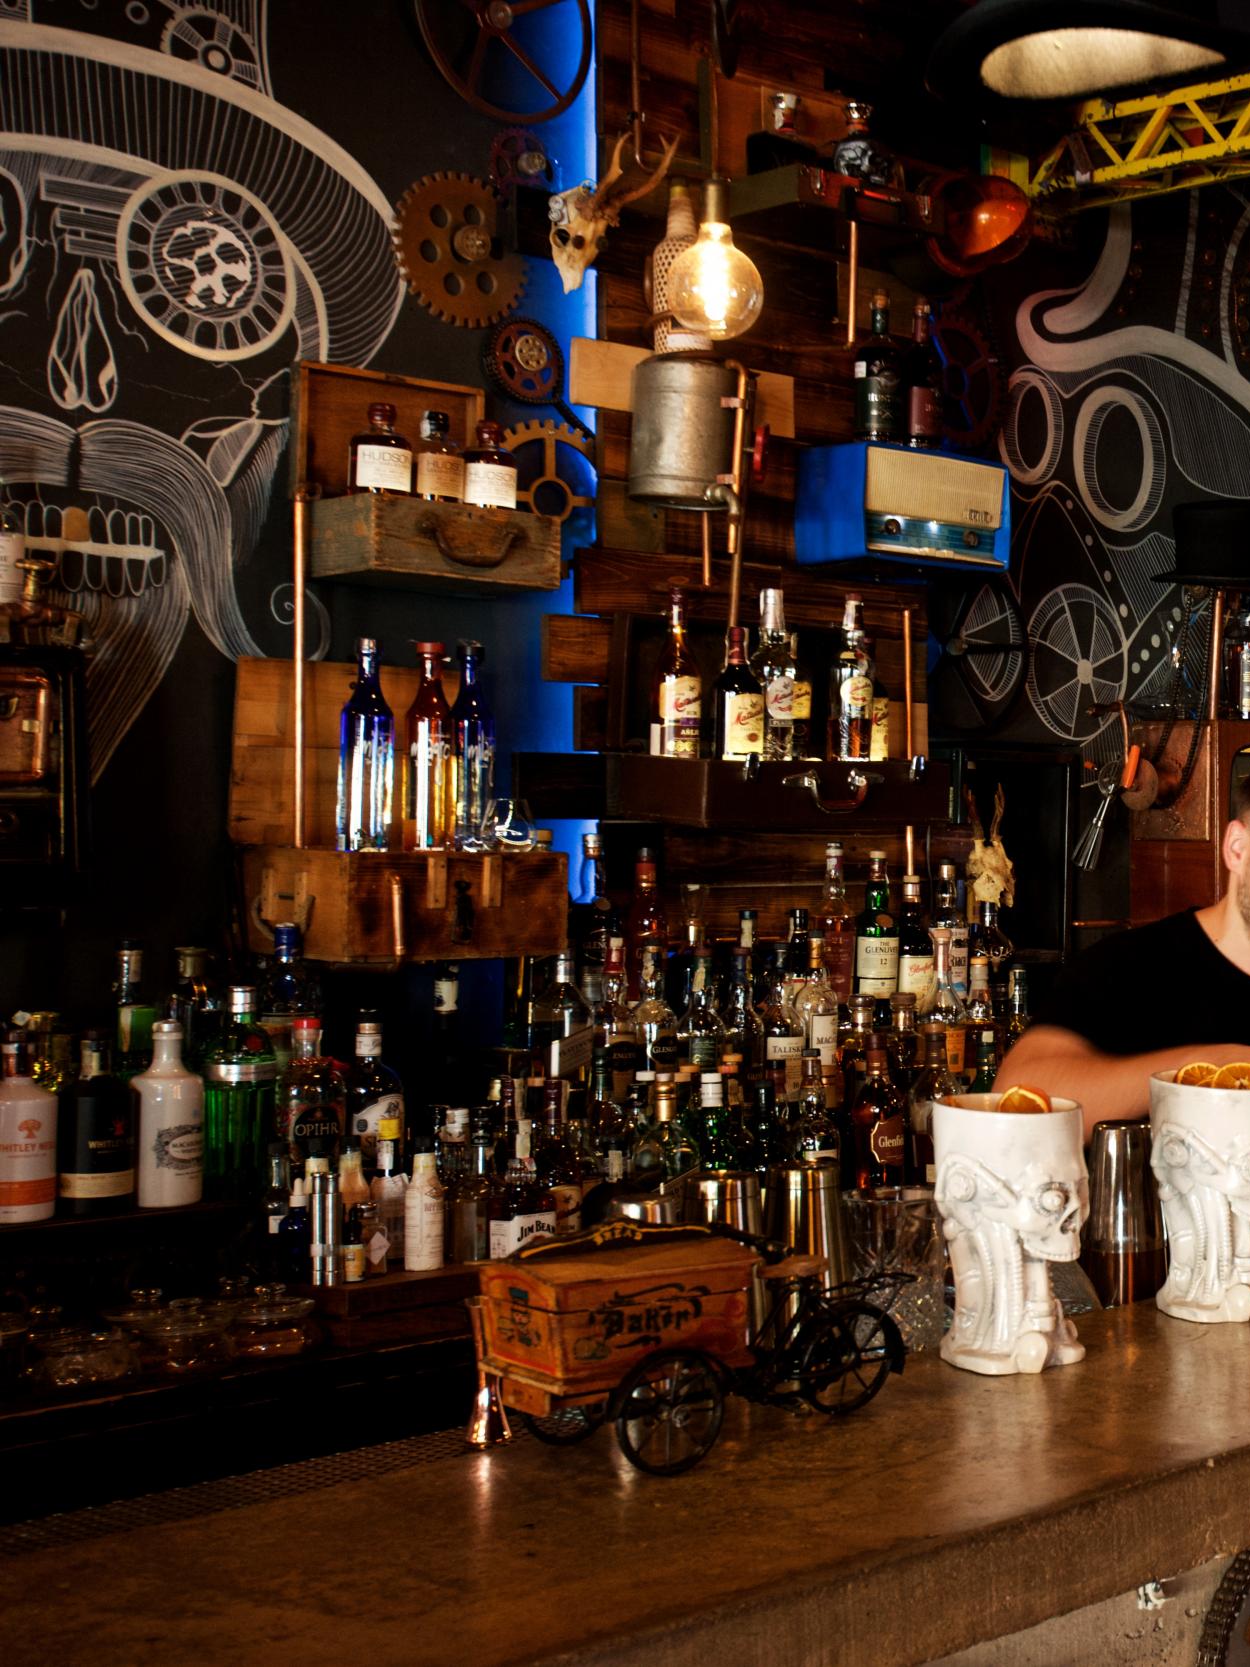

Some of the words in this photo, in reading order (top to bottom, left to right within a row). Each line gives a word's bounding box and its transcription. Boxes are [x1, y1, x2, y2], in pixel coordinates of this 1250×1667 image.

[880, 958, 888, 966] 12
[295, 1121, 339, 1137] OPIHR
[517, 1224, 535, 1242] JIM
